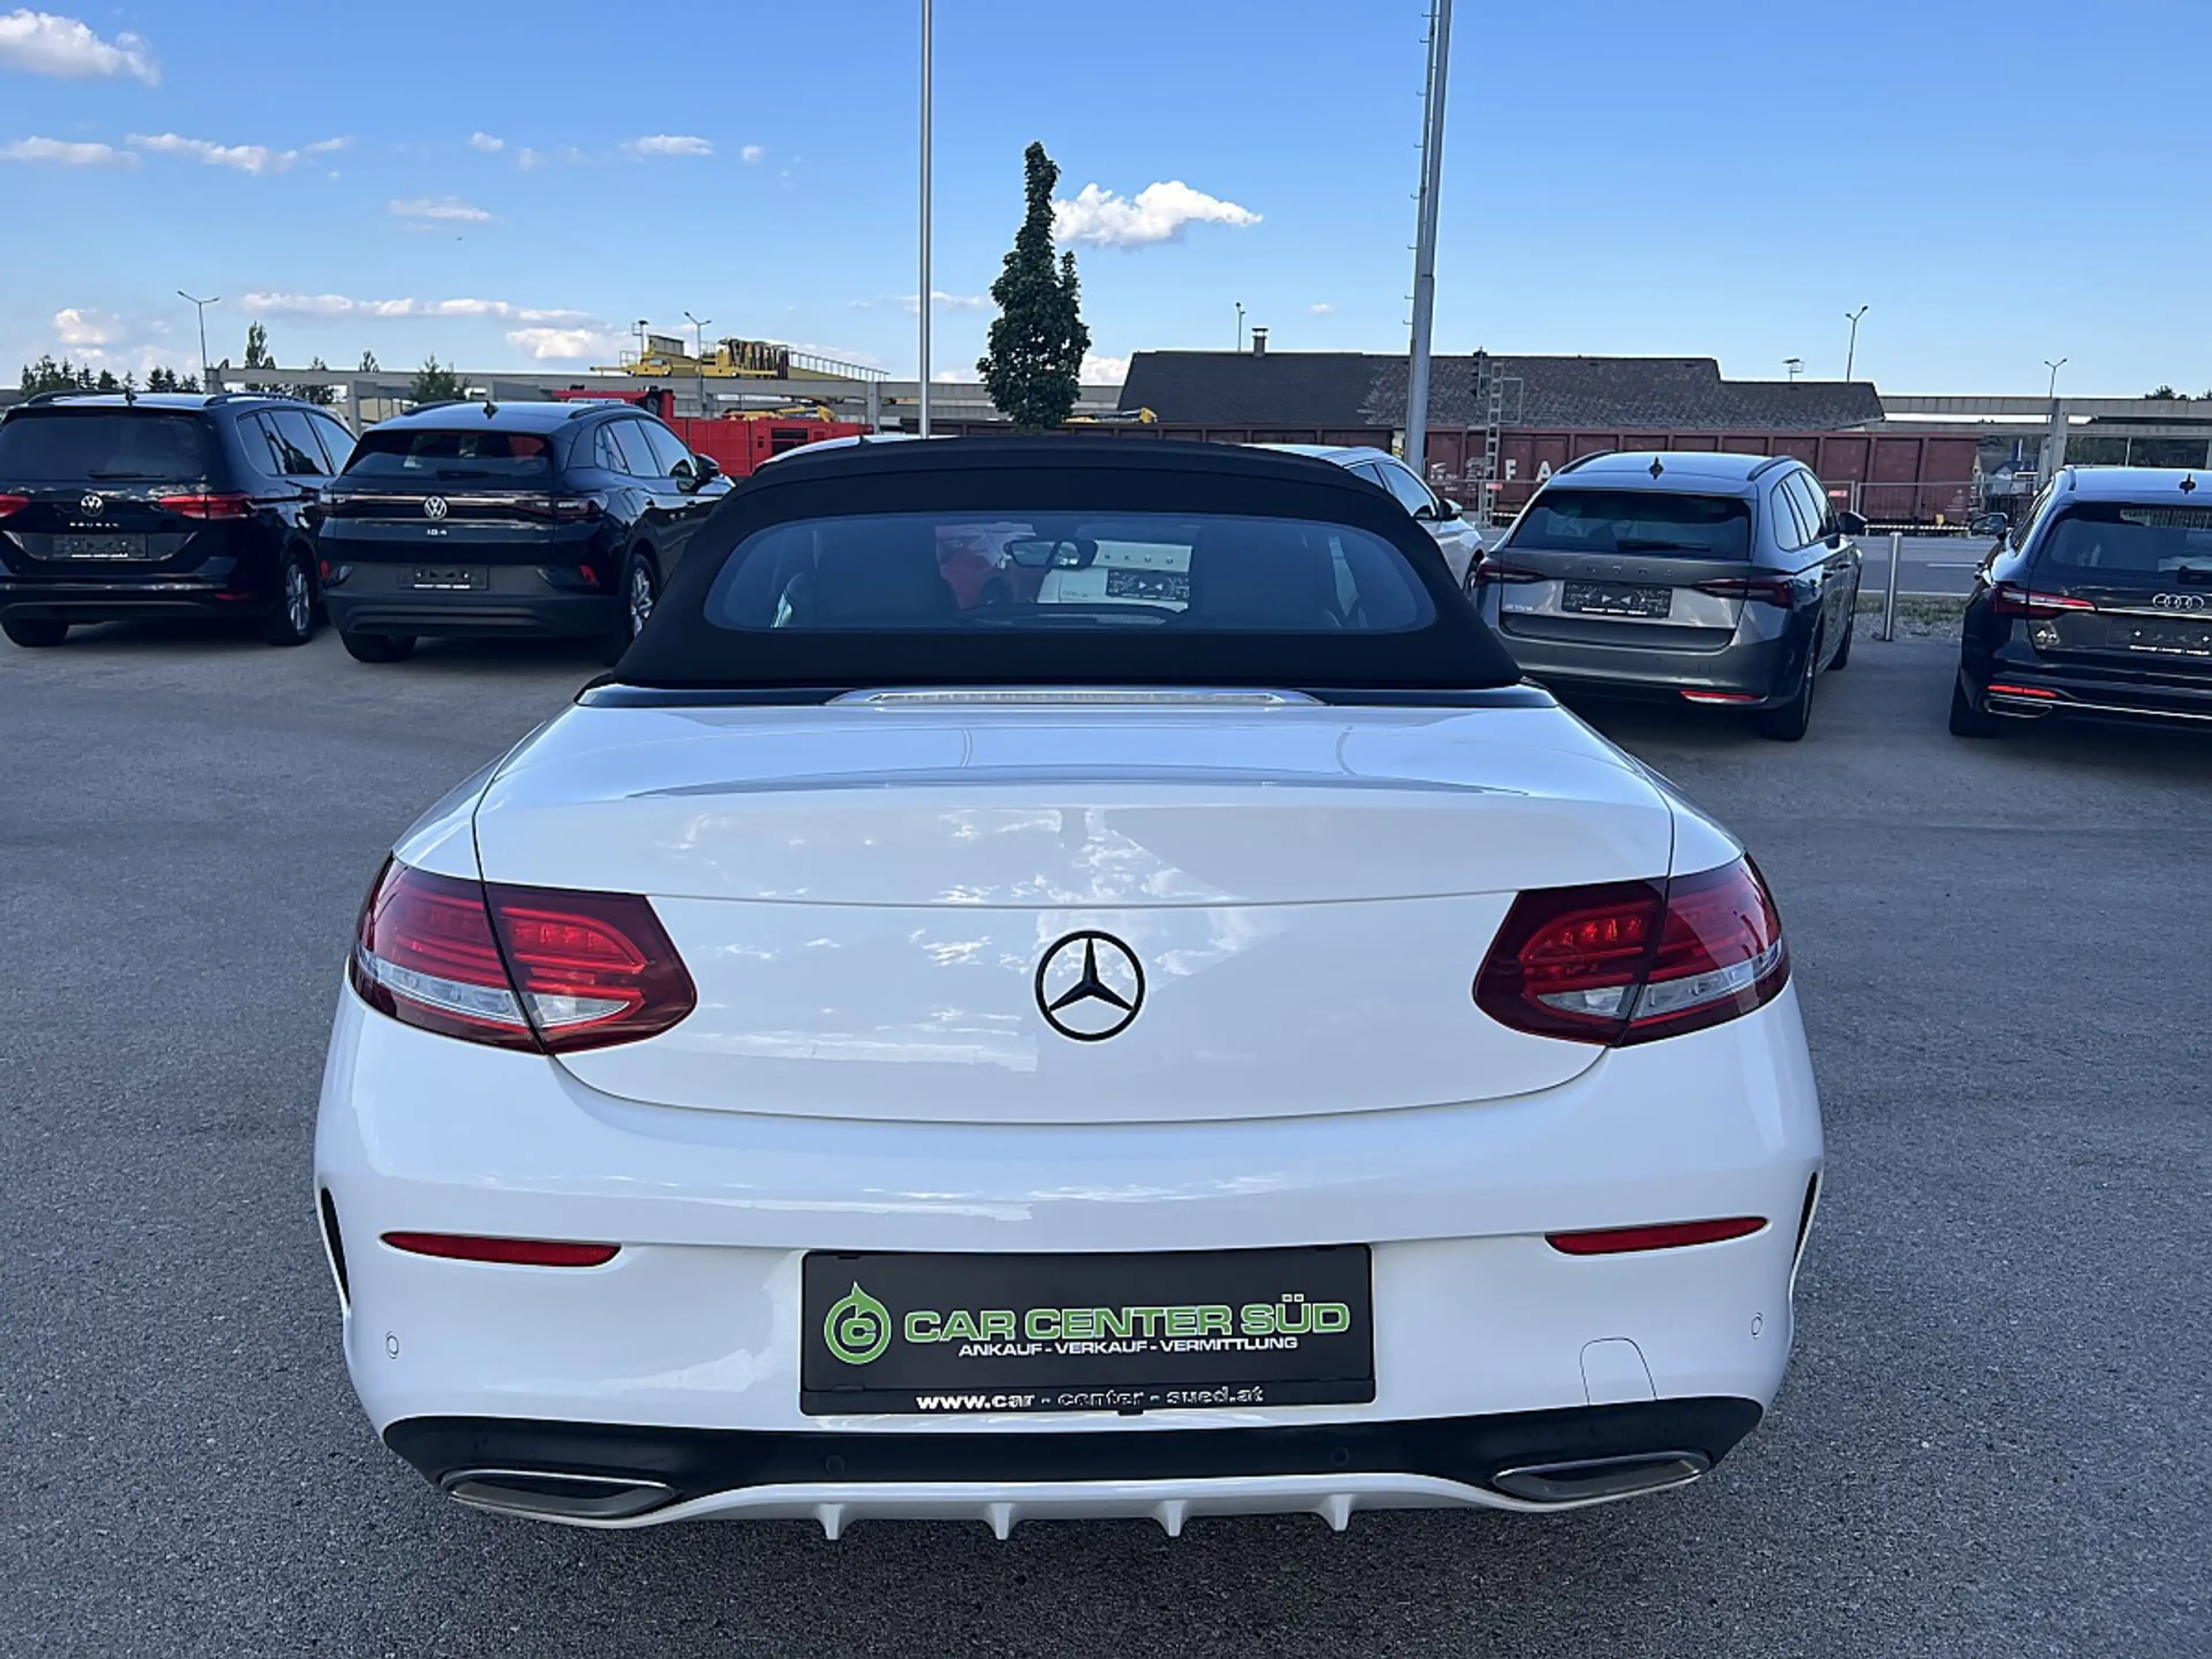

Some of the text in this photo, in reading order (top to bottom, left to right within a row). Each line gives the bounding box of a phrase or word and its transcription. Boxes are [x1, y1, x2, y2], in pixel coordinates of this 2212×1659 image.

[904, 1294, 1350, 1342] CAR CENTER SÜD
